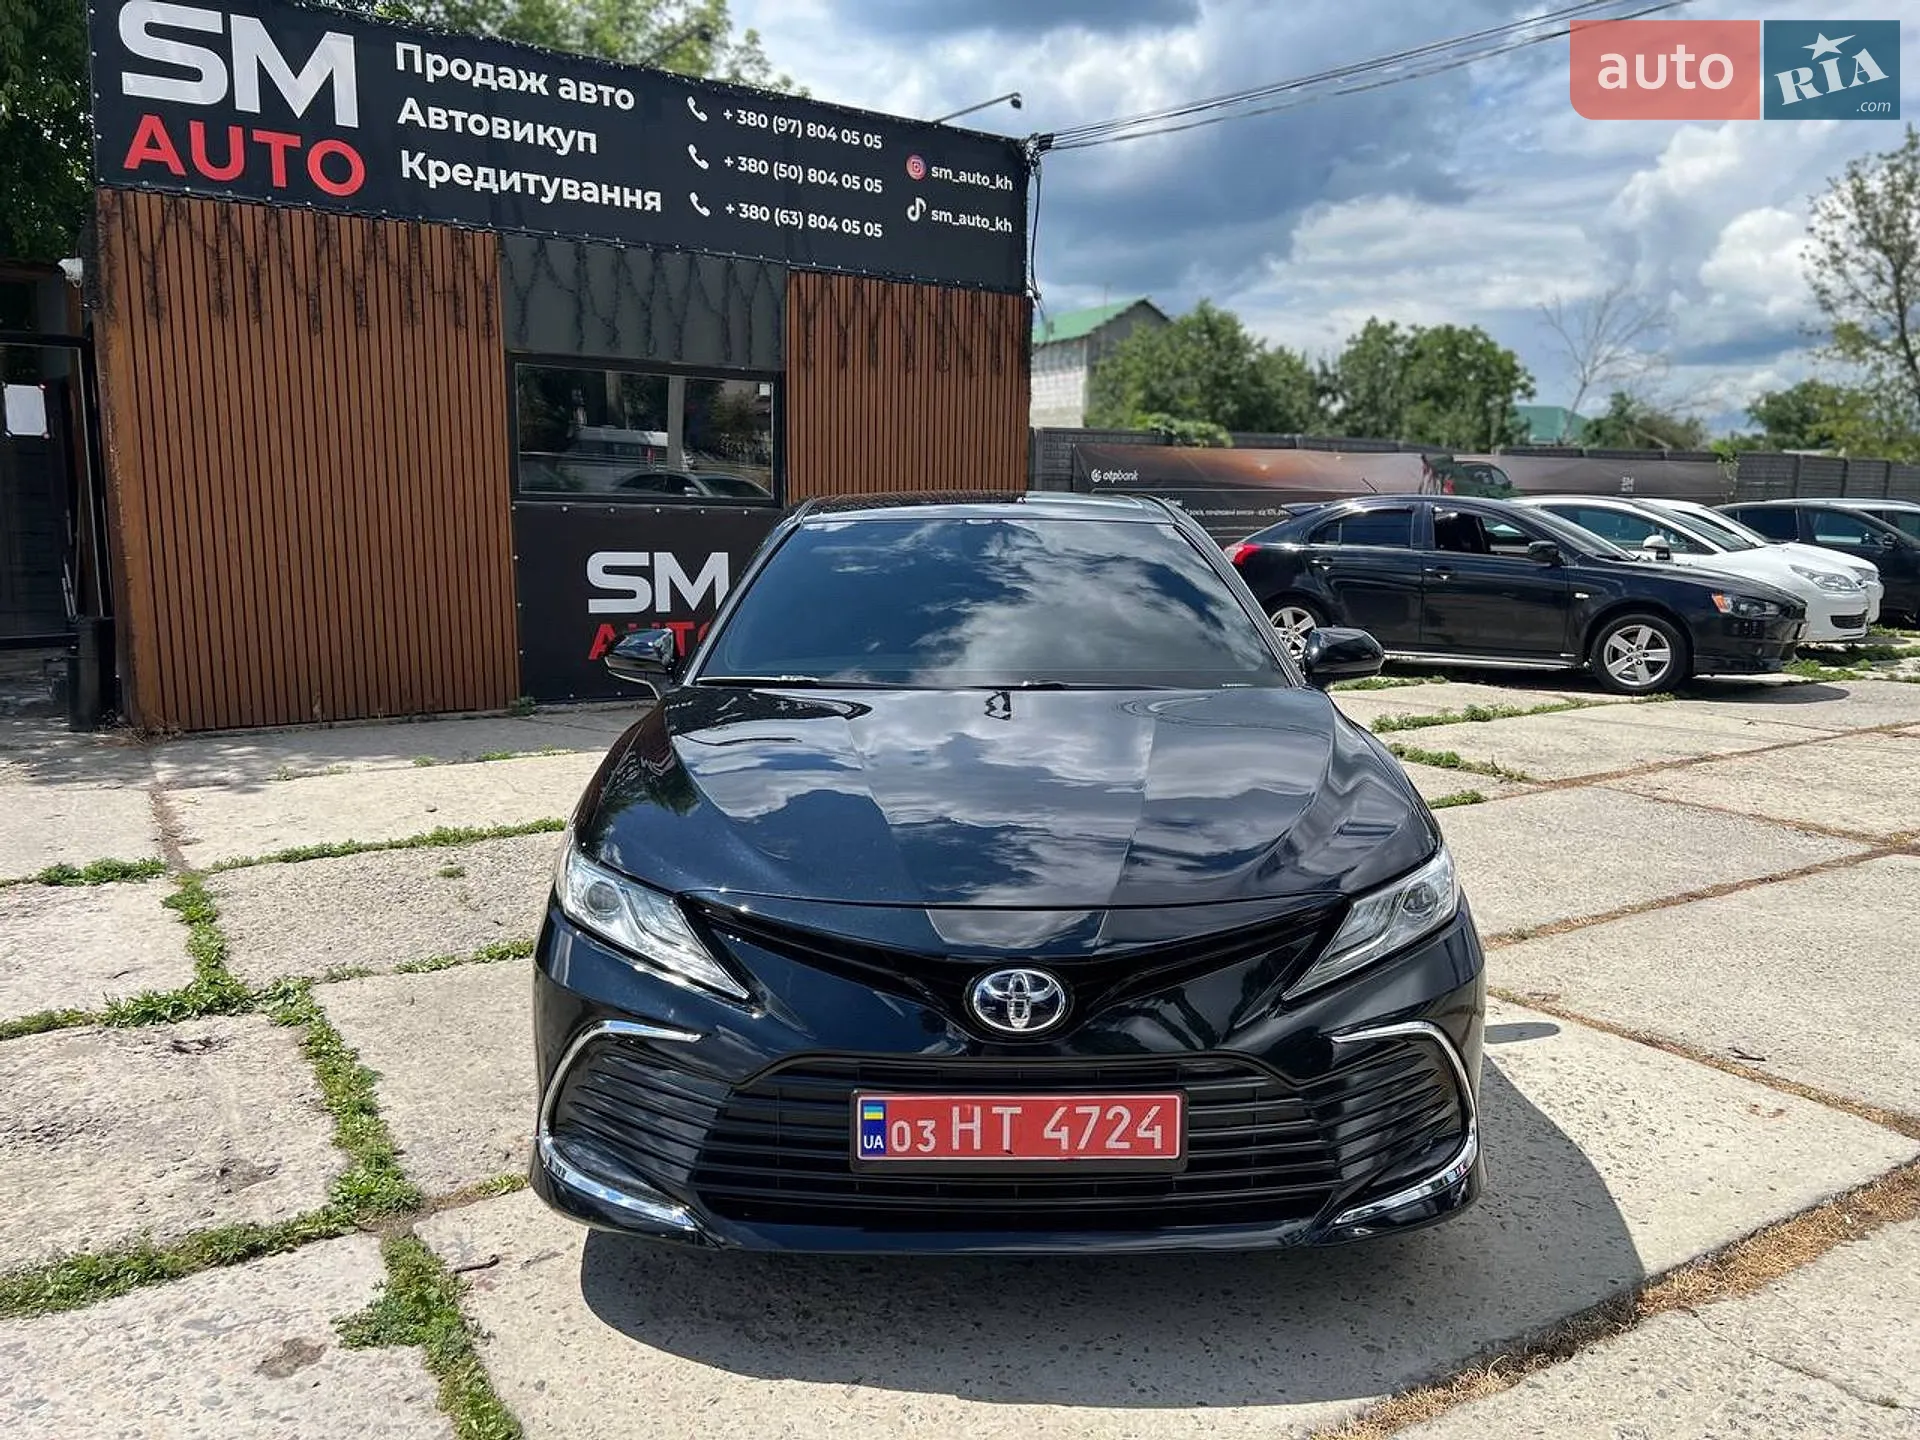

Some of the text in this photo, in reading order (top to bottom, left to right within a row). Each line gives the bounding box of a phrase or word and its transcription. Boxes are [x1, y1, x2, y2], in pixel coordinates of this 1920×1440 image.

[118, 0, 360, 129] SM
[396, 41, 636, 111] Продаж авто
[397, 97, 598, 156] Автовикуп
[737, 109, 768, 129] 380
[772, 115, 803, 139] (97)
[806, 122, 838, 142] 804
[841, 128, 861, 146] 05
[863, 132, 883, 150] 05
[123, 113, 367, 197] AUTO
[737, 155, 768, 175] 380
[773, 161, 804, 185] (50)
[807, 167, 838, 187] 804
[841, 173, 861, 190] 05
[863, 177, 883, 194] 05
[930, 164, 1013, 191] sm_auto_kh
[401, 150, 662, 213] Кредитування
[738, 202, 770, 222] 380
[774, 208, 804, 230] (63)
[807, 213, 838, 232] 804
[841, 218, 861, 235] 05
[863, 221, 883, 238] 05
[930, 207, 1013, 233] sm_auto_kh
[586, 551, 730, 613] SM
[863, 1134, 884, 1149] UA
[890, 1105, 1163, 1152] 03 HT 4724
